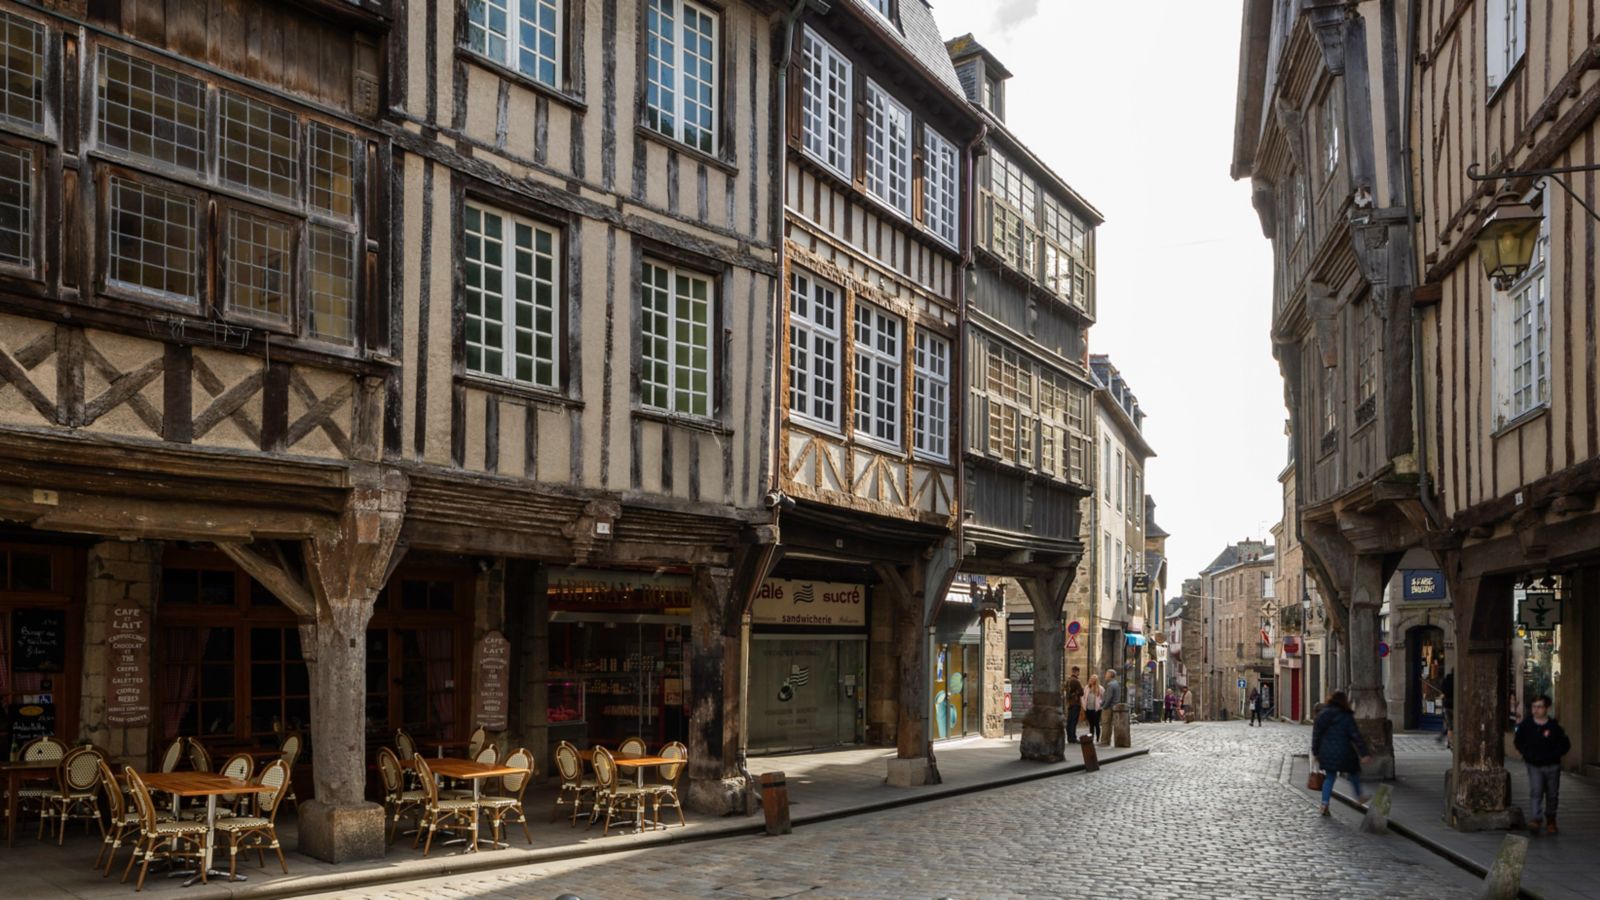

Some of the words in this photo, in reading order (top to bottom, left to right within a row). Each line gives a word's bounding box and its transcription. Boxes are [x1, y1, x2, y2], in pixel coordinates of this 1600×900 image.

[823, 586, 860, 604] sucré
[782, 614, 832, 624] sandwicherie
[112, 620, 143, 629] LAIT
